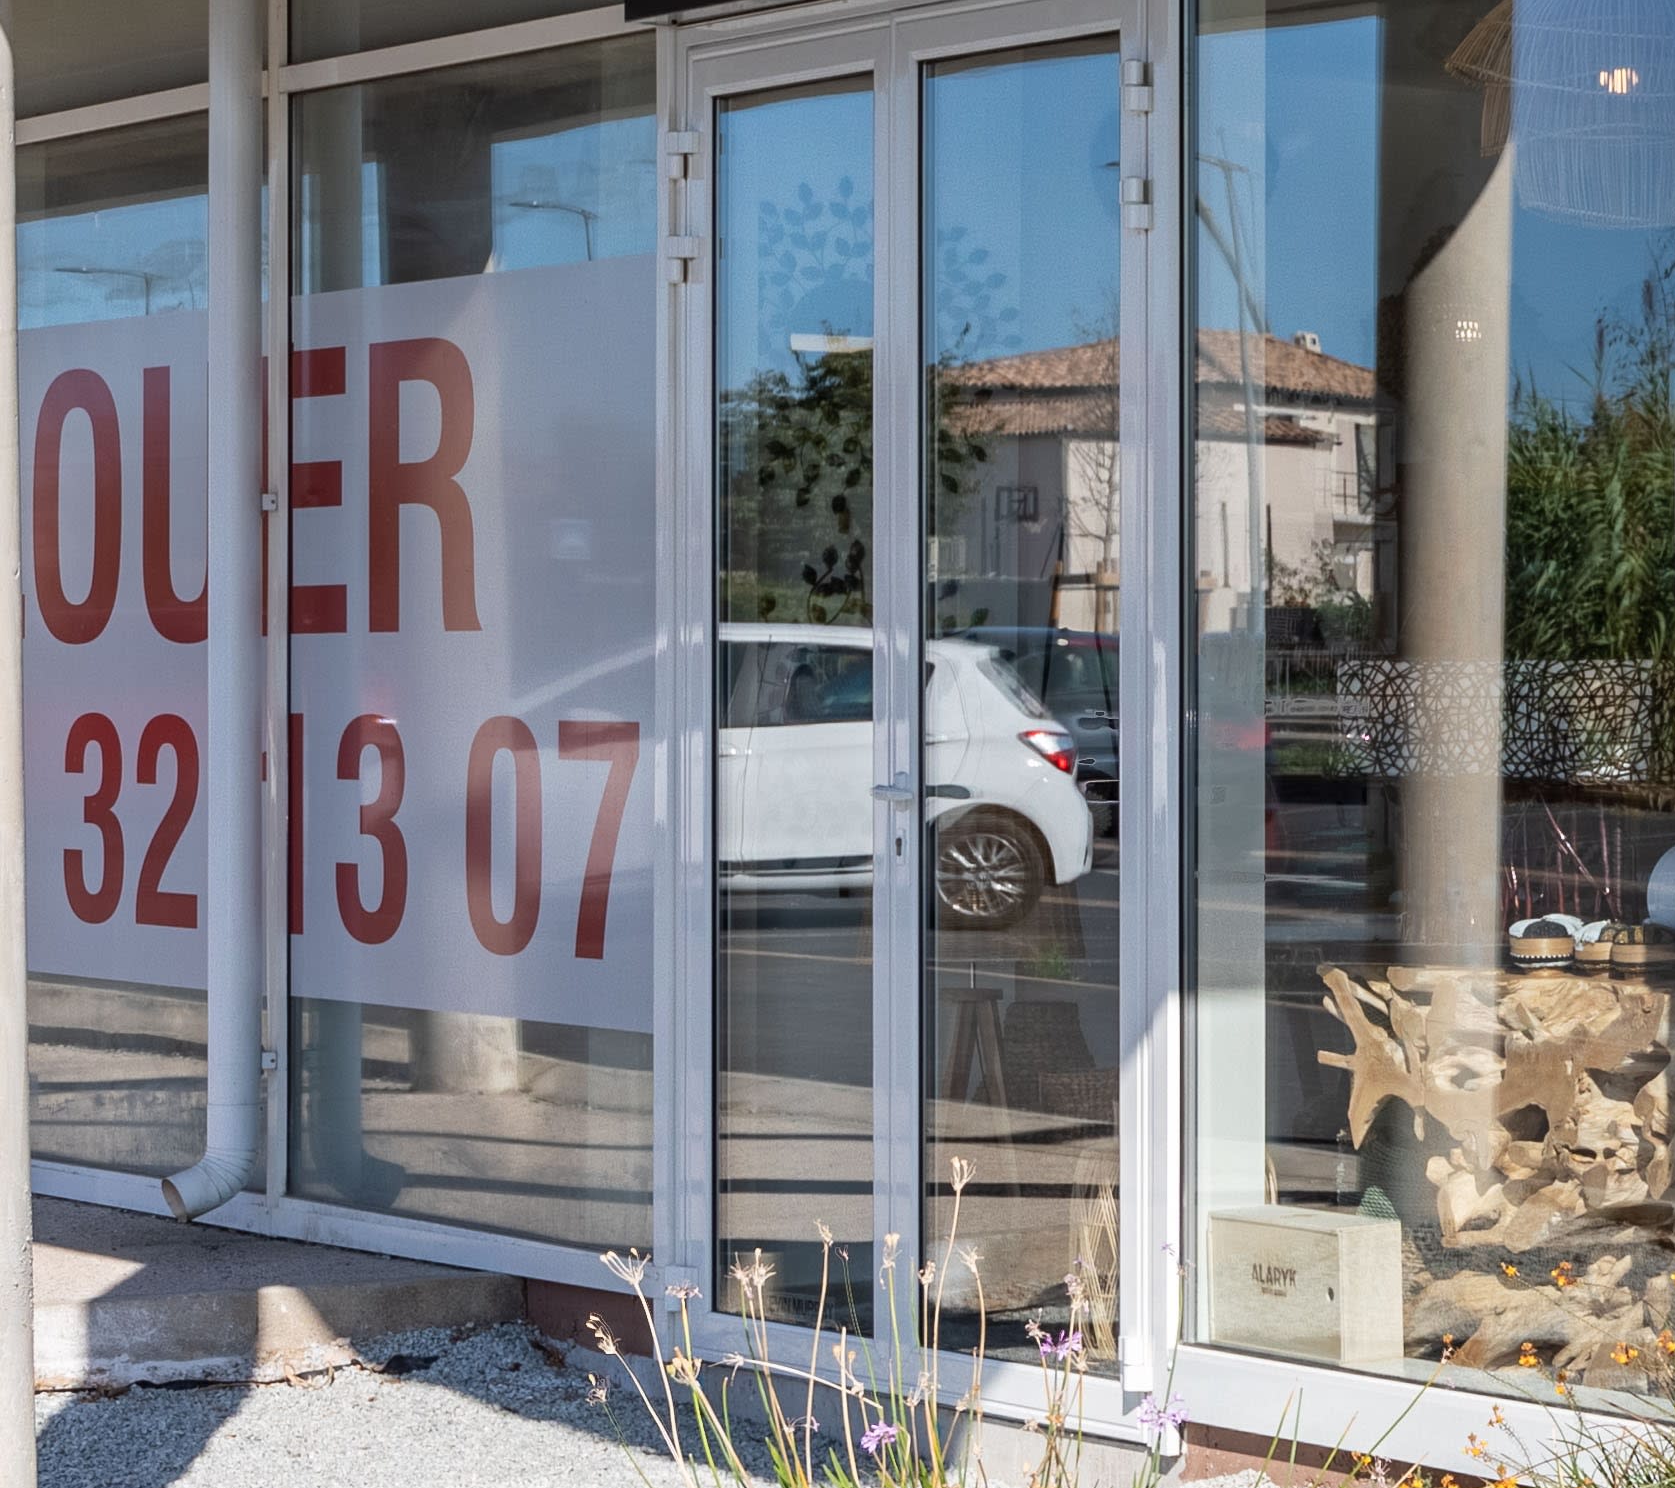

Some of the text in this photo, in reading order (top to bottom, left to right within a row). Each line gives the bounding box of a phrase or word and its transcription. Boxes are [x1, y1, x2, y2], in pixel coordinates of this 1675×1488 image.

[22, 337, 483, 645] OUER
[63, 712, 200, 929] 32
[465, 715, 641, 961] 07
